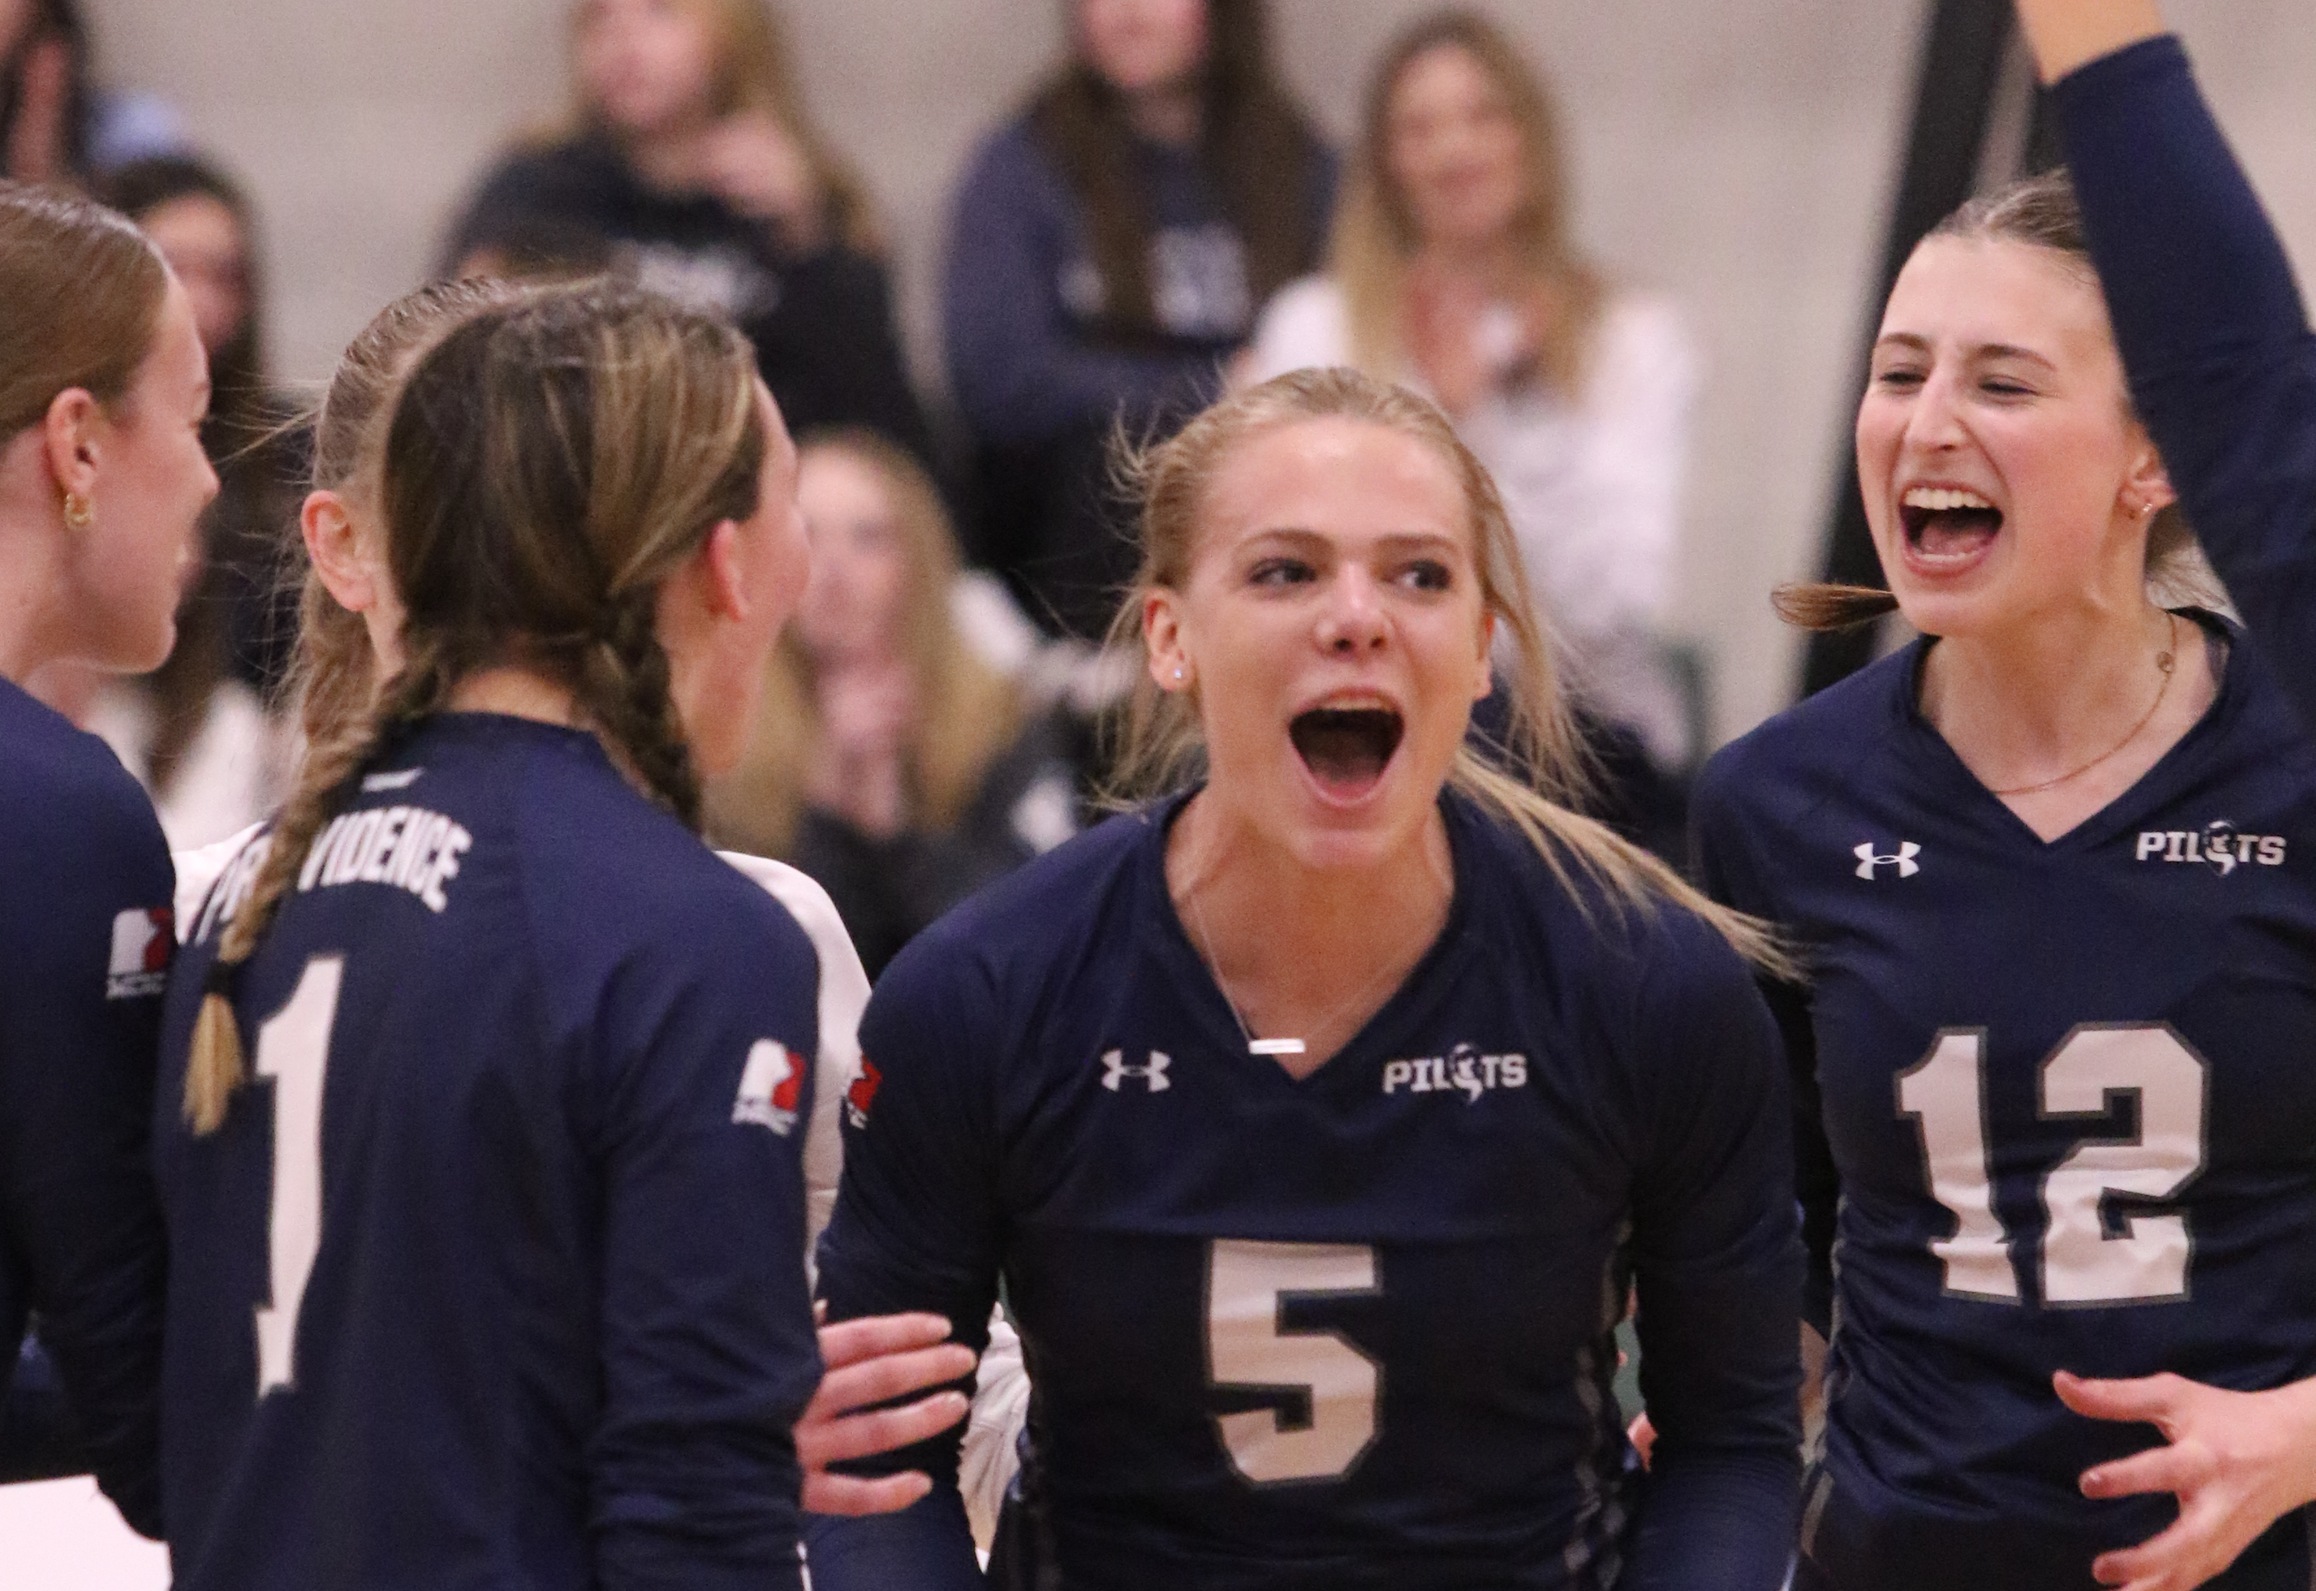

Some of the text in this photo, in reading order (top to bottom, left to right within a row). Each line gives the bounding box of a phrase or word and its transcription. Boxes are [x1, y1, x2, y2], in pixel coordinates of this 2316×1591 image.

[195, 805, 472, 947] PRVIDENCE
[255, 953, 346, 1402] 1
[1895, 1021, 2212, 1310] 12
[1207, 1237, 1386, 1491] 5
